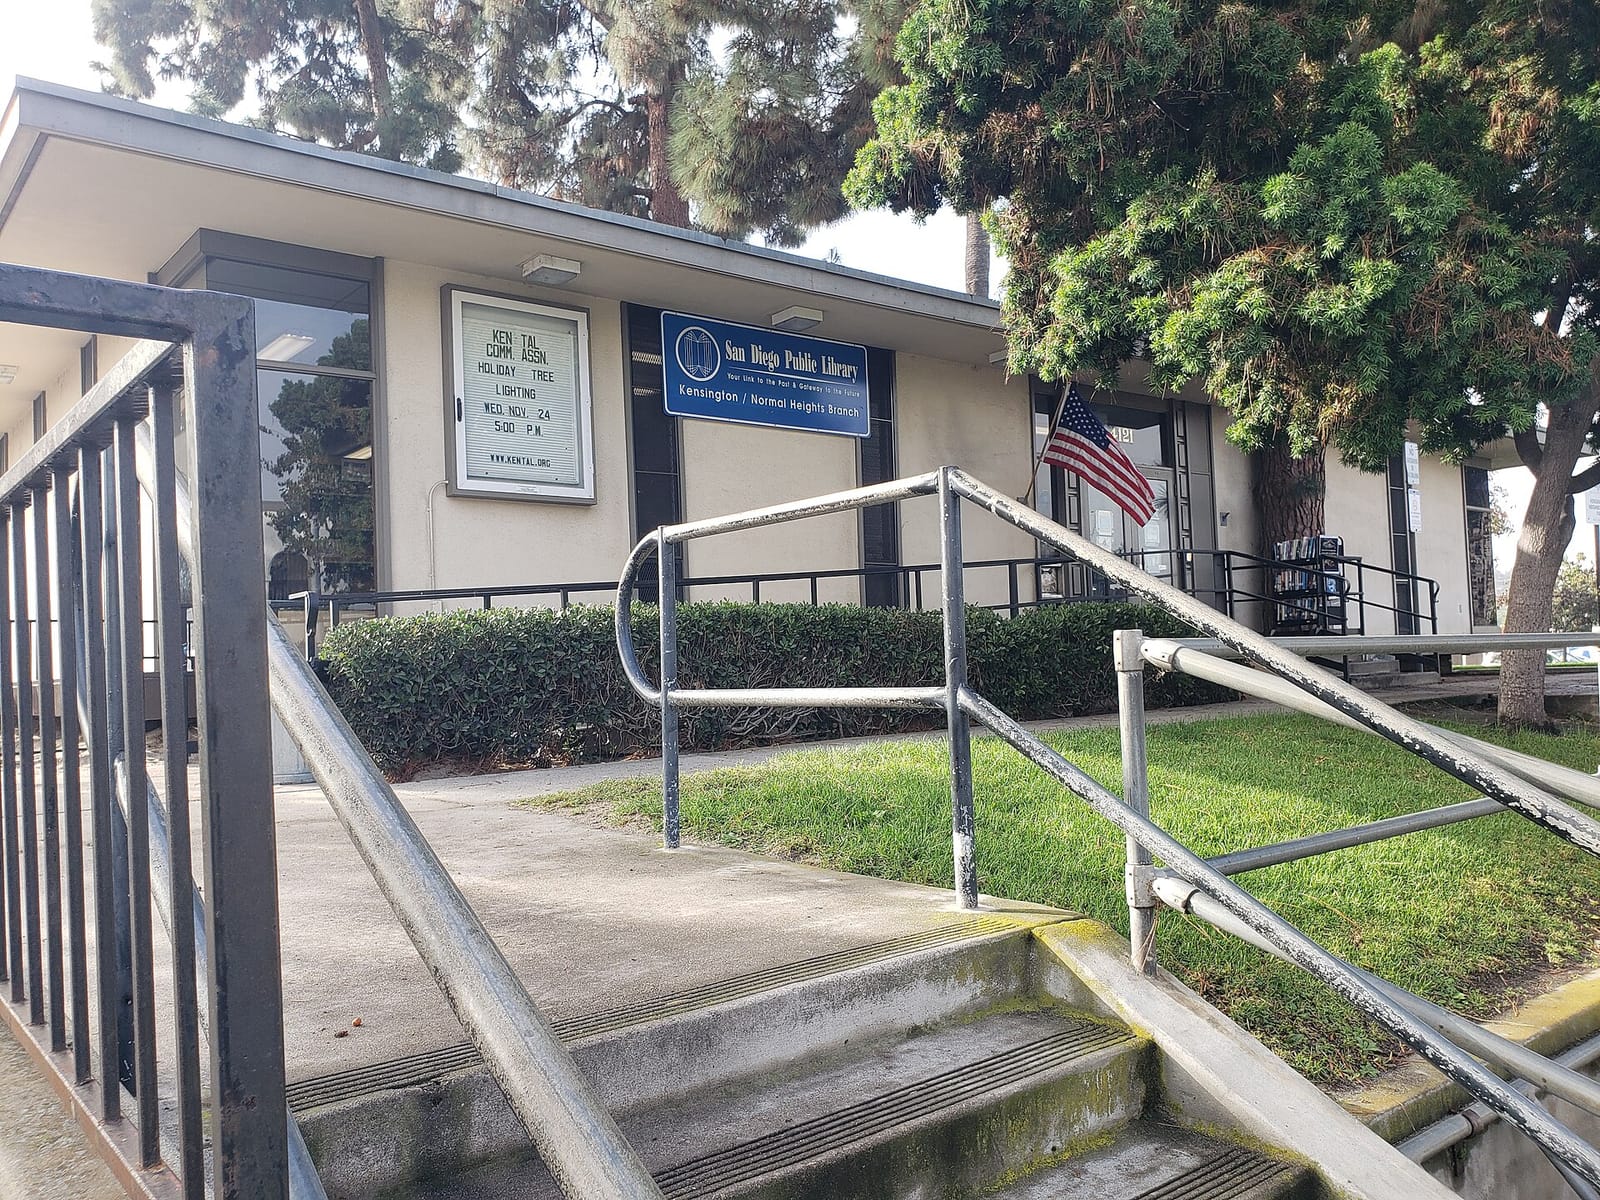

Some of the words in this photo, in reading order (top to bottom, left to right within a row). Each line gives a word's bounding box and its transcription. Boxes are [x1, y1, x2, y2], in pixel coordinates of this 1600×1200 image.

[492, 329, 513, 345] KEN
[521, 334, 540, 350] TAL
[486, 343, 515, 361] COMM.
[521, 348, 549, 366] ASSN.
[725, 339, 746, 362] San
[750, 342, 780, 372] Diego
[784, 349, 818, 374] Public
[821, 355, 859, 384] Library
[478, 361, 516, 377] HOLIDAY
[531, 369, 555, 383] TREE
[496, 384, 536, 400] LIGHTING
[727, 372, 741, 381] Your
[743, 374, 755, 383] Link
[757, 376, 764, 384] to
[766, 378, 776, 386] the
[778, 380, 790, 388] Past
[792, 381, 797, 389] &
[798, 383, 823, 393] Gateway
[833, 388, 842, 396] the
[844, 388, 860, 398] Future
[483, 401, 505, 416] WED.
[508, 405, 529, 418] NOV.
[538, 408, 551, 420] 24
[679, 383, 739, 402] Kensington
[751, 393, 787, 409] Normal
[790, 399, 825, 414] Heights
[828, 404, 859, 418] Branch
[494, 420, 515, 434] 5:00
[526, 424, 544, 437] P.M.
[490, 454, 551, 468] WWW.KENTAL.ORG
